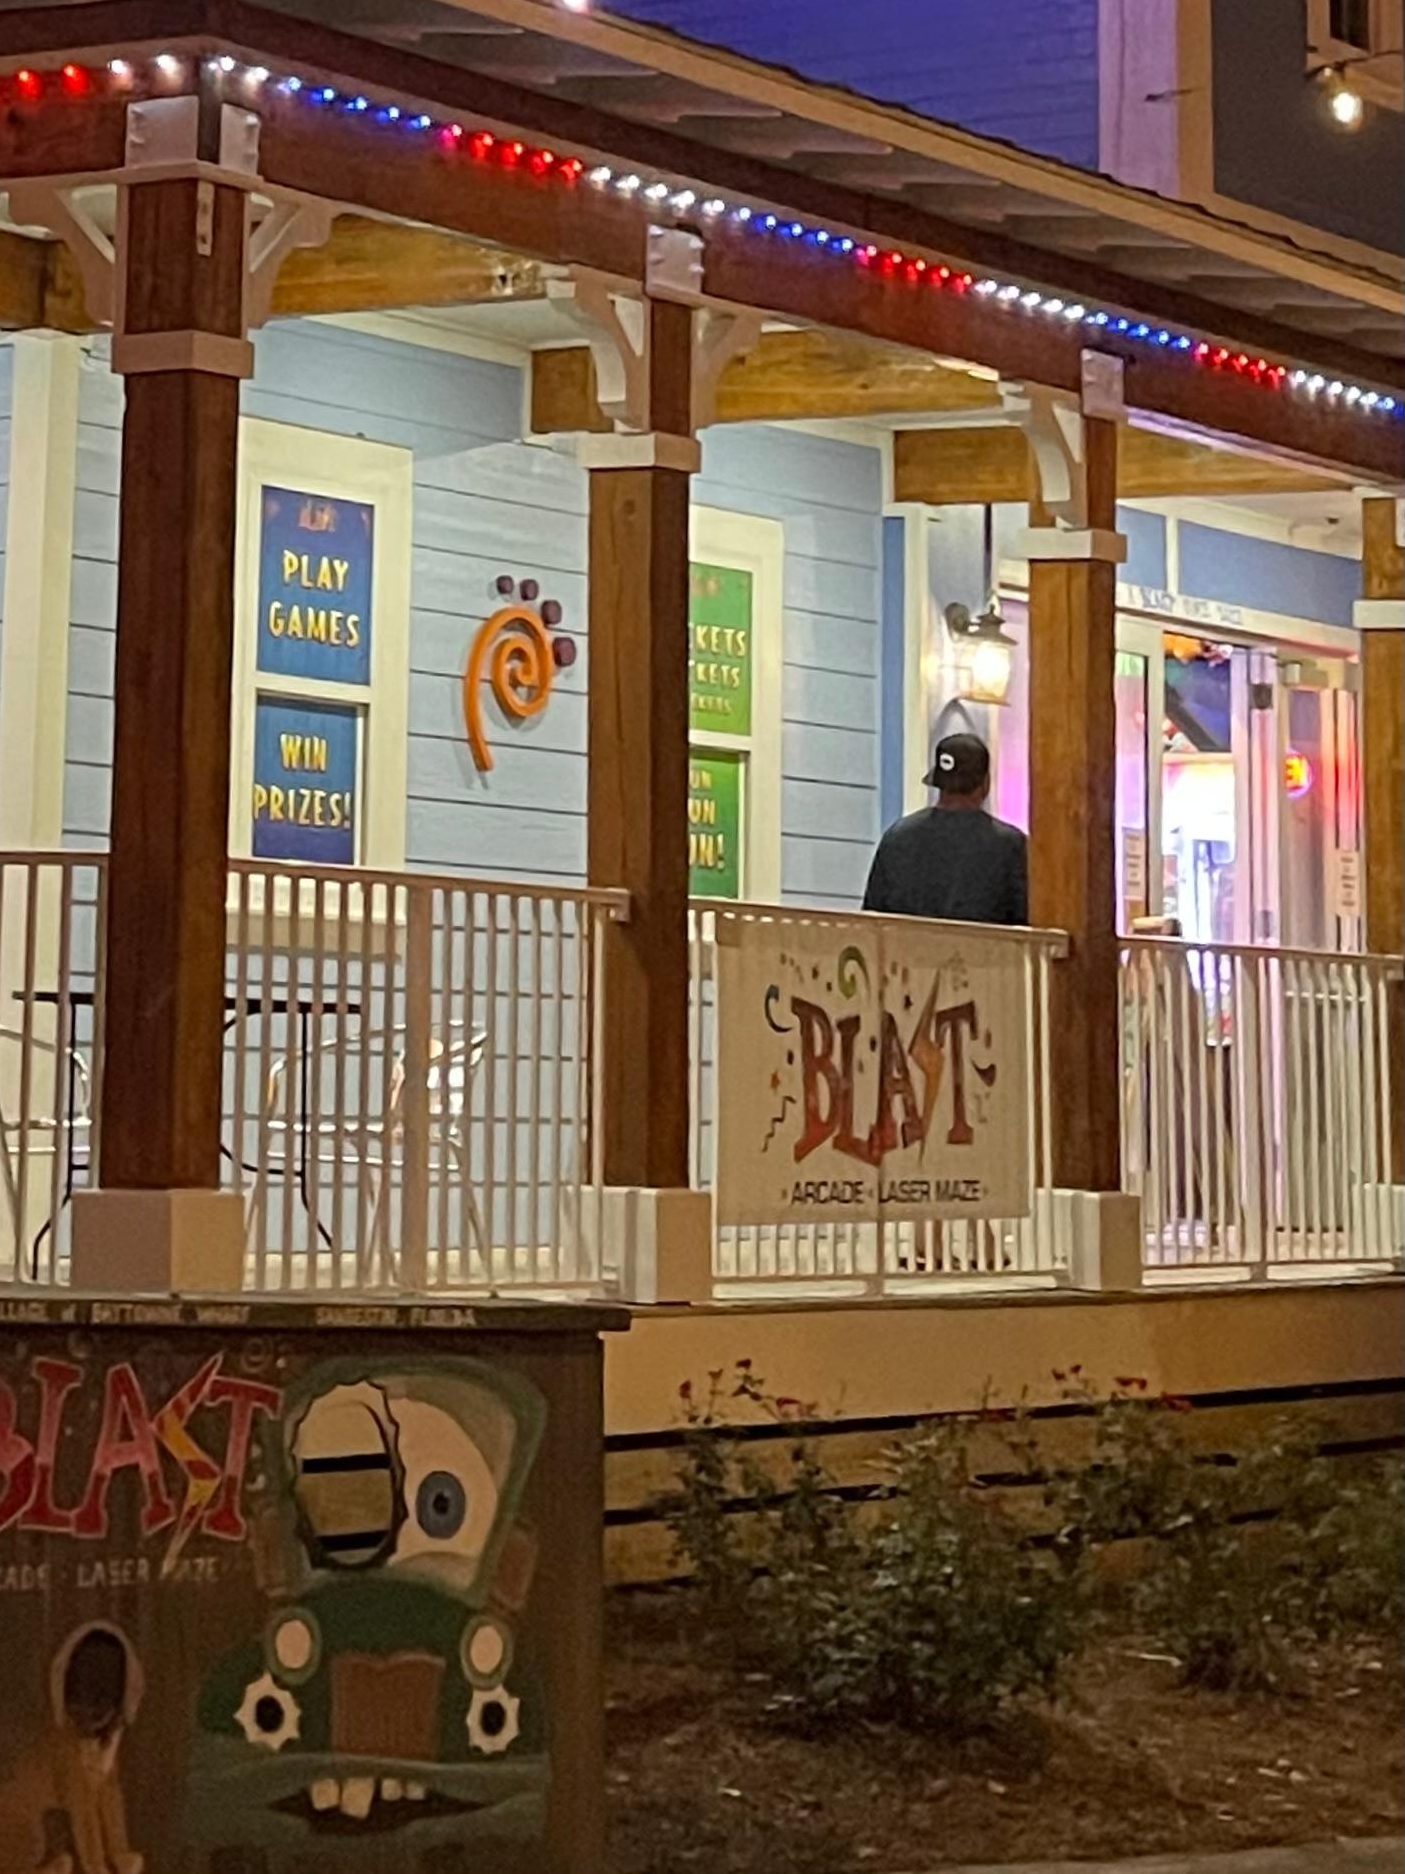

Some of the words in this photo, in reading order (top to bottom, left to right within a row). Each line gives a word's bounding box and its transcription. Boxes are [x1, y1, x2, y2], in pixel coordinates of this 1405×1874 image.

[282, 549, 349, 592] PLAY
[268, 601, 361, 647] GAMES
[690, 624, 747, 657] KETS
[279, 732, 328, 772] WIN
[254, 783, 352, 829] PRIZES!
[688, 797, 715, 825] UN
[790, 967, 979, 1167] BLAST
[791, 1180, 864, 1205] ARCADE
[877, 1181, 932, 1204] LASER
[935, 1179, 982, 1201] MAZE
